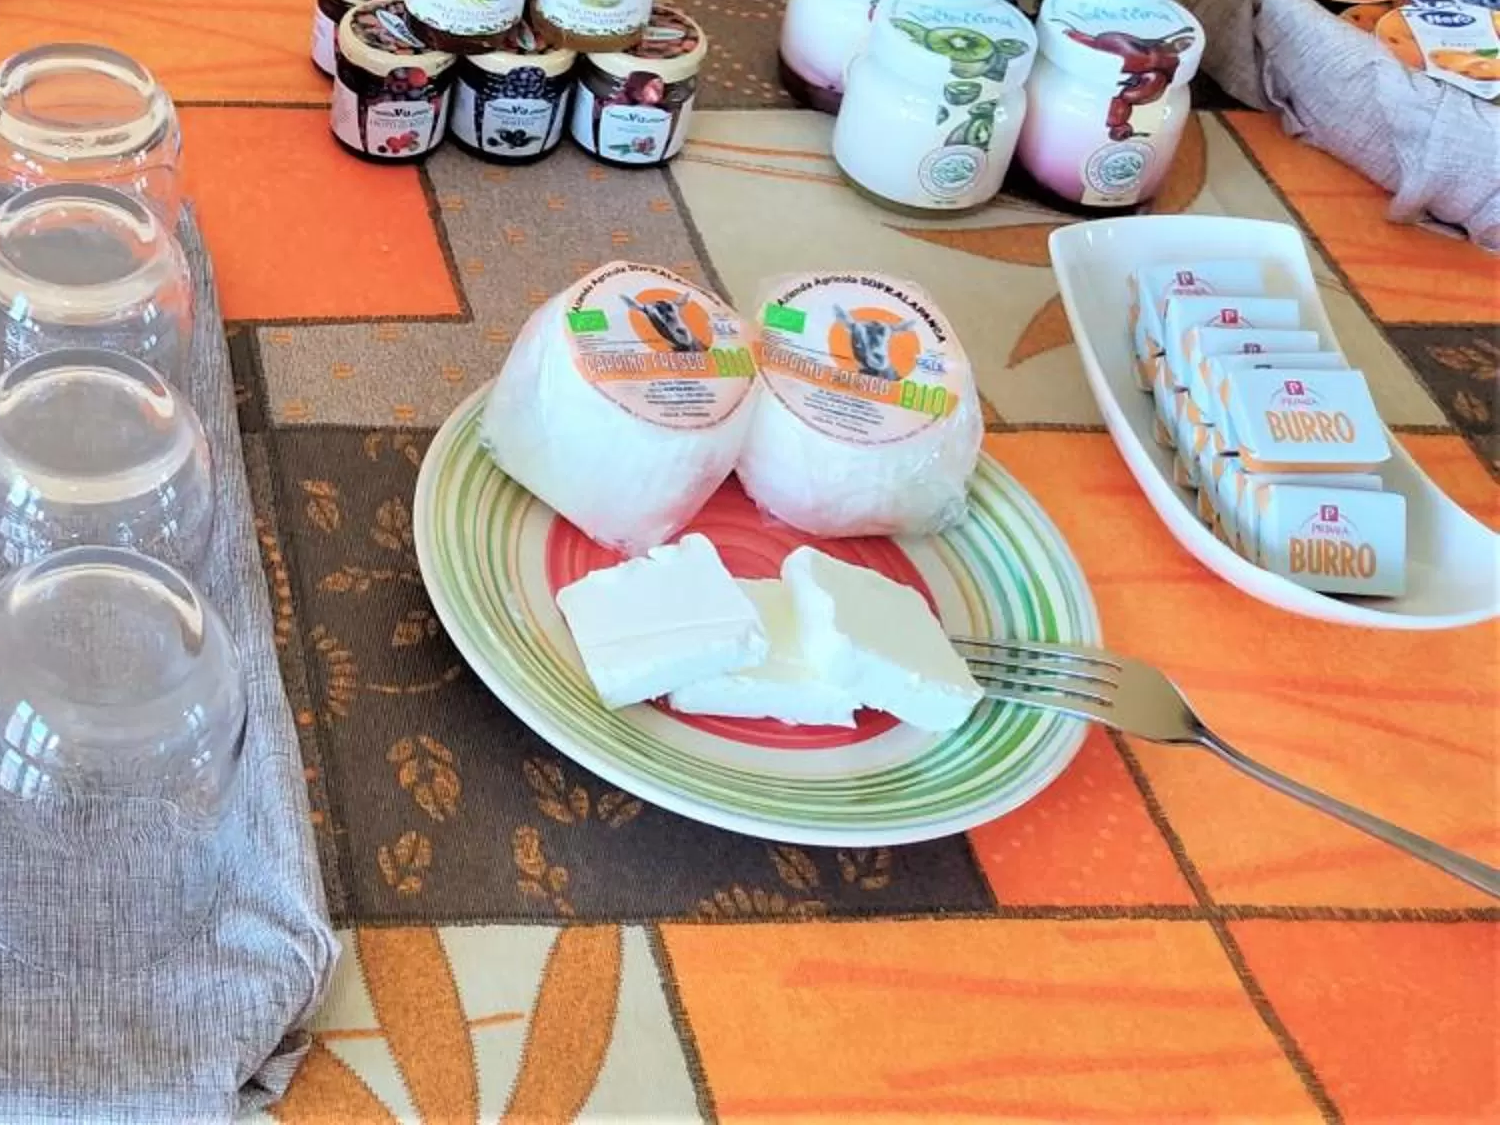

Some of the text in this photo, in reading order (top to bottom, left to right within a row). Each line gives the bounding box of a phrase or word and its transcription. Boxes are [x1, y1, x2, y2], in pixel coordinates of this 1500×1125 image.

[901, 379, 947, 414] BIO
[1264, 410, 1357, 444] BURRO
[1287, 538, 1378, 579] BURRO
